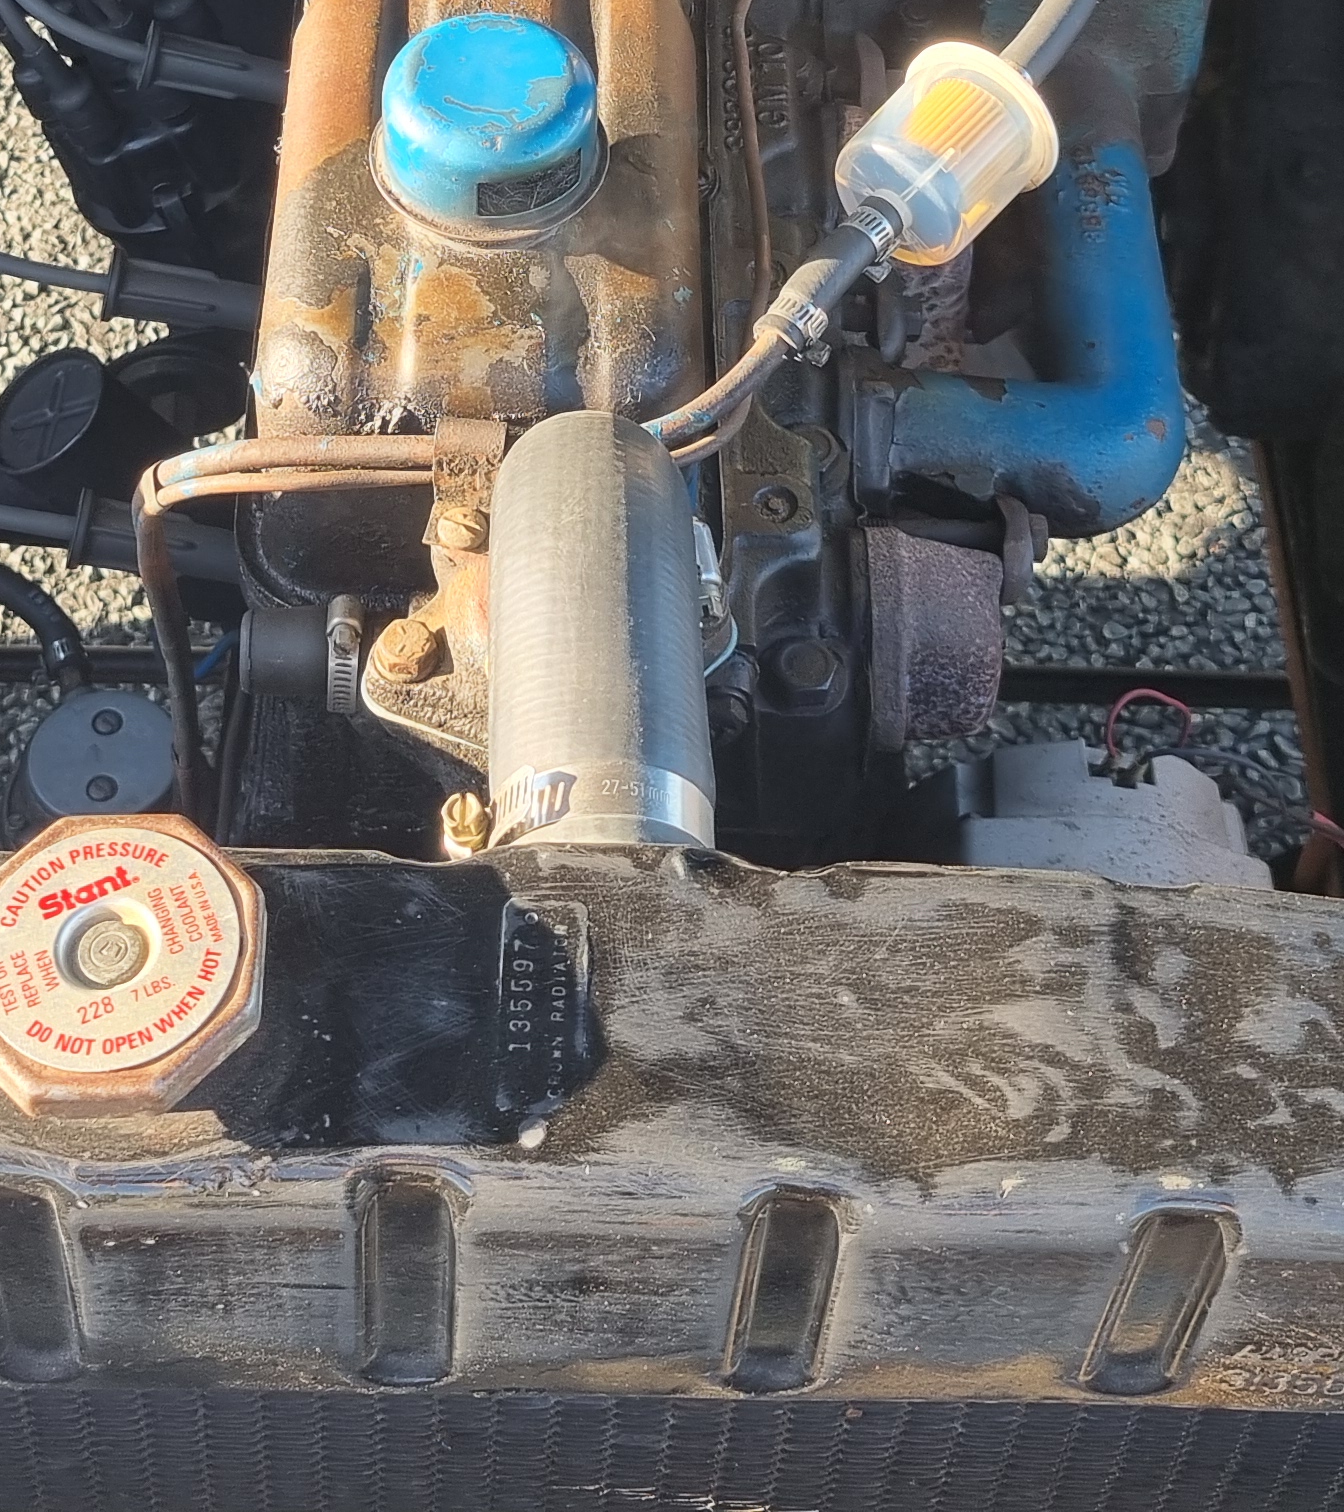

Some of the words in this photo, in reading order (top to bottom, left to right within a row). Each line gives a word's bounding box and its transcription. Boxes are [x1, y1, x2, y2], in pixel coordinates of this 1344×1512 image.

[0, 857, 66, 928] CAUTION
[68, 841, 169, 869] PRESSURE
[37, 865, 133, 921] Stant
[168, 885, 203, 943] COOLANT
[147, 887, 184, 955] CHANGING
[204, 911, 224, 943] MADE
[10, 949, 42, 1008] REPLACE
[34, 949, 60, 992] WHEN
[76, 995, 115, 1025] 228
[130, 989, 143, 1003] 7
[143, 975, 177, 999] LBS.
[508, 938, 537, 1053] 135597
[550, 924, 570, 1023] RADIATOR
[25, 1019, 54, 1043] DO
[54, 1033, 96, 1055] NOT
[101, 1027, 155, 1055] OPEN
[152, 985, 206, 1035] WHEN
[197, 947, 223, 982] HOT
